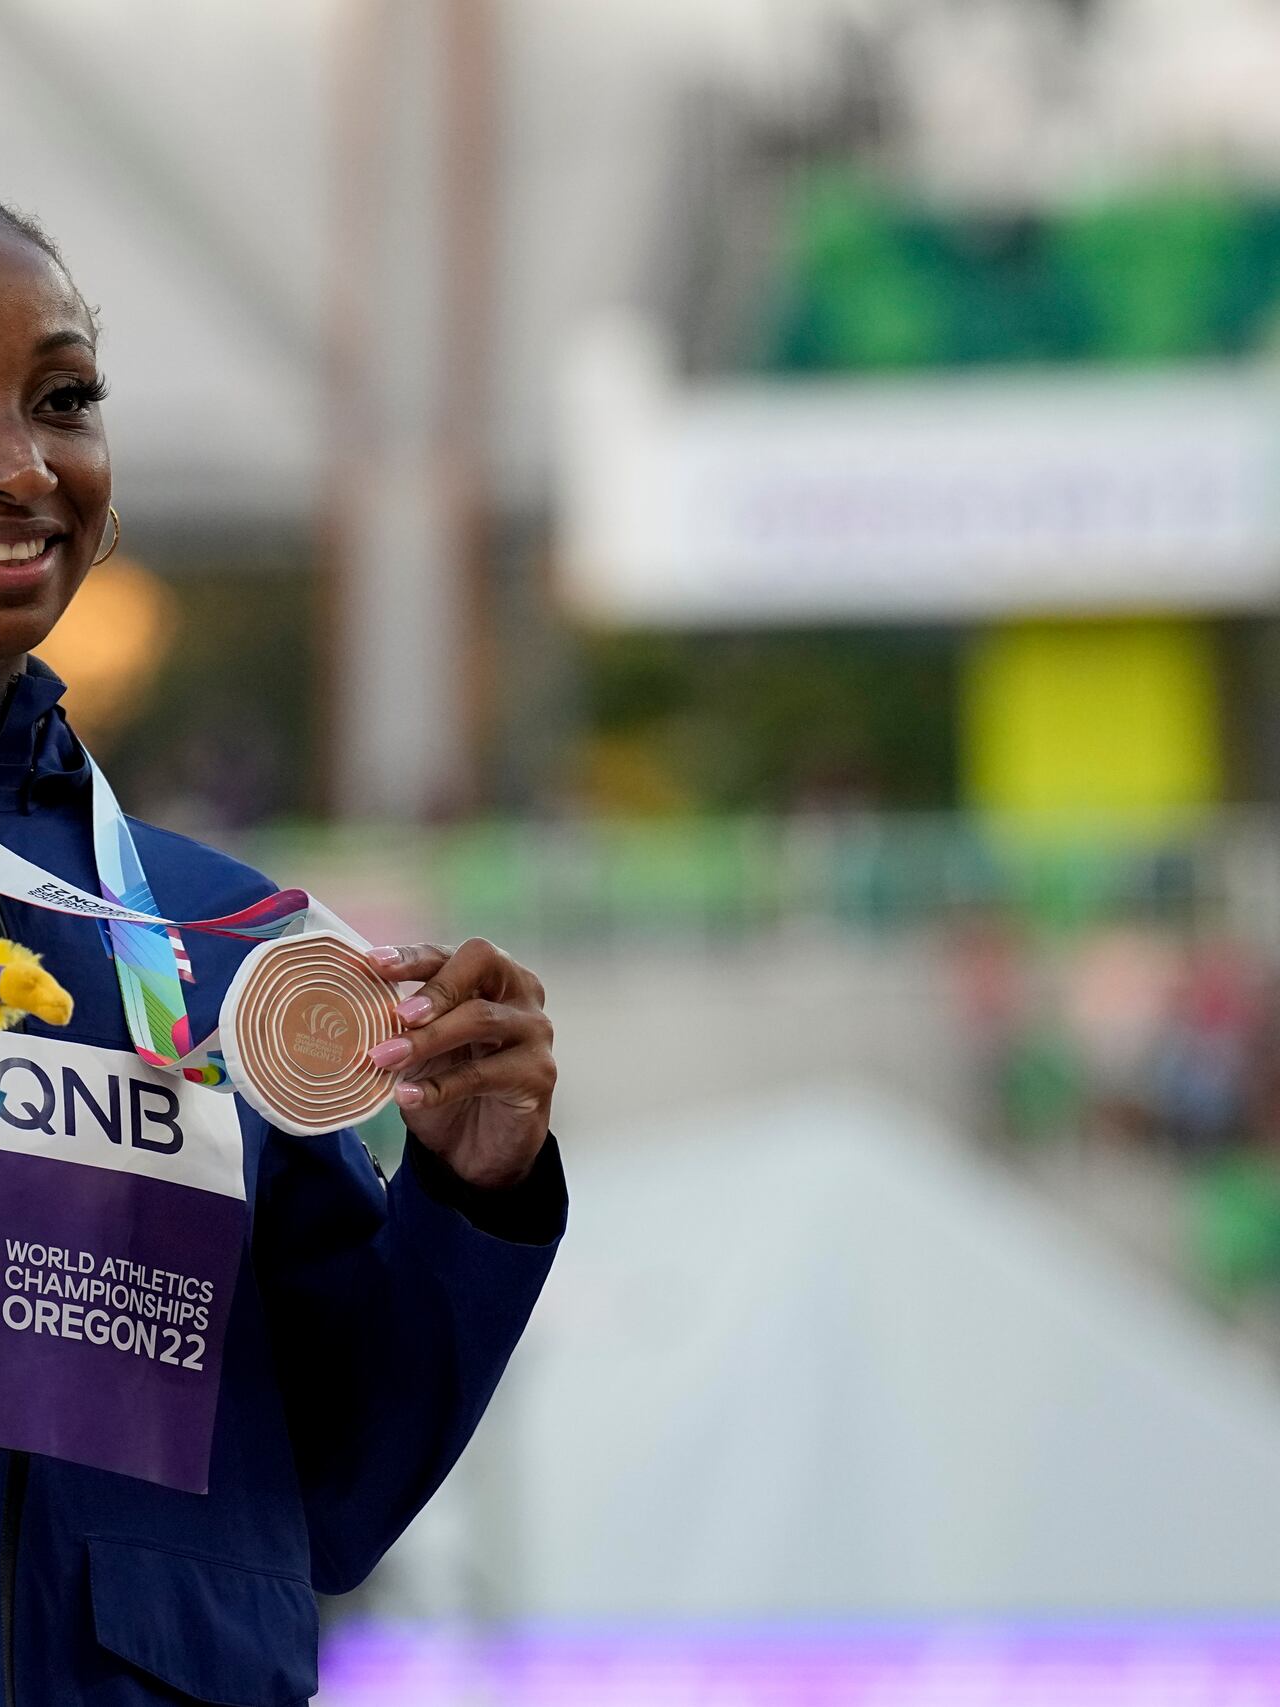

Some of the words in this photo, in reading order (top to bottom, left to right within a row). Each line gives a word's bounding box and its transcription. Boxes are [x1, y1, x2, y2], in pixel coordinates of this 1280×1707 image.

[4, 1265, 209, 1331] CHAMPIONSHIPS
[5, 1239, 95, 1274] WORLD
[99, 1256, 214, 1304] ATHLETICS
[2, 1294, 206, 1371] OREGON22
